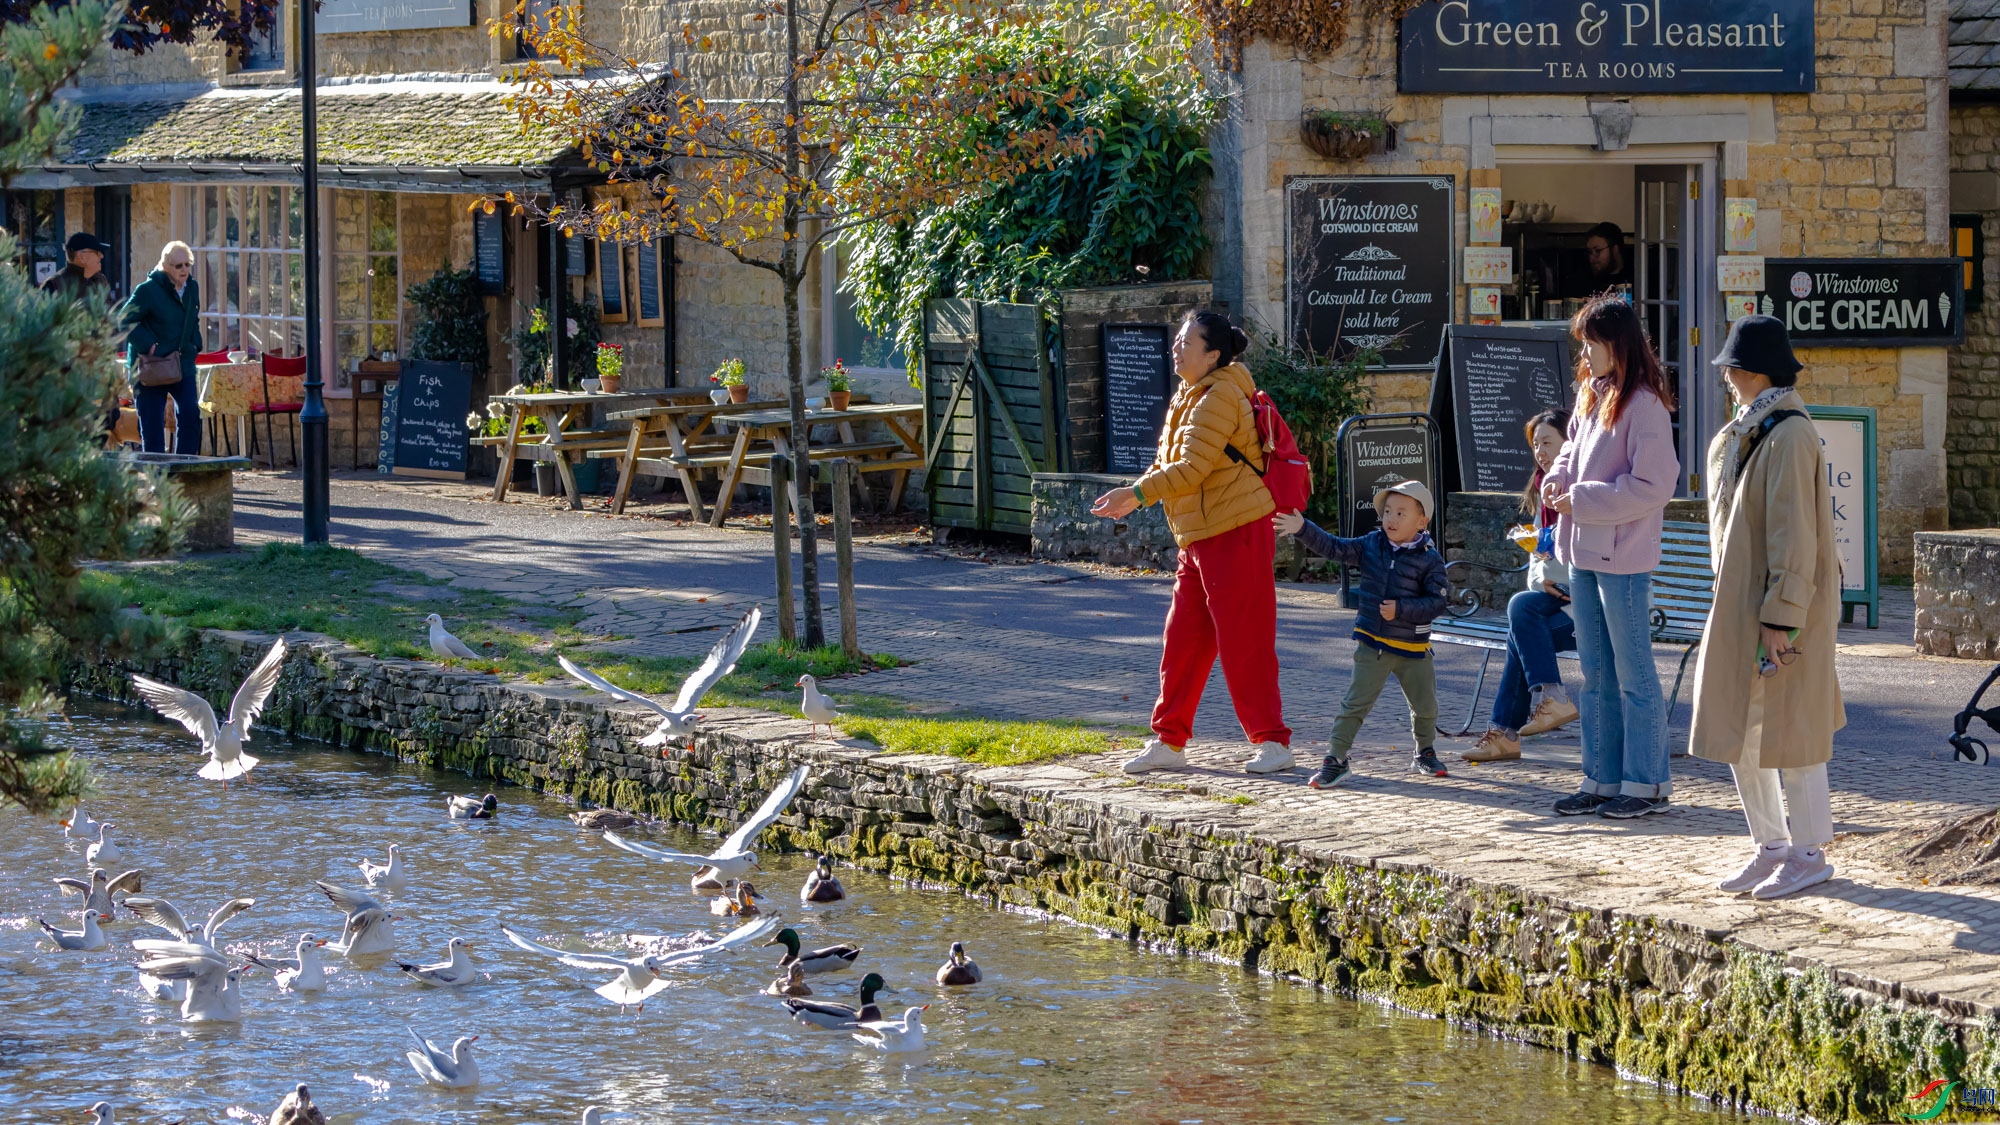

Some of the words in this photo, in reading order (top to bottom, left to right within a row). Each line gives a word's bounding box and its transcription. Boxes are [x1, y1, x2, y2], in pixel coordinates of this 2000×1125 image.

[384, 4, 414, 19] ROOMS
[1435, 1, 1561, 47] Green
[1575, 1, 1608, 47] &
[1621, 0, 1786, 48] Pleasant
[1544, 62, 1589, 79] TEA
[1599, 62, 1676, 79] ROOMS
[1318, 197, 1419, 221] Winstones
[1321, 223, 1371, 234] COTSWOLD
[1372, 223, 1386, 233] ICE
[1386, 223, 1419, 233] CREAM
[1334, 265, 1407, 282] Traditional
[1814, 273, 1899, 295] Winstones
[1307, 289, 1366, 306] Cotswold
[1369, 289, 1388, 304] Ice
[1391, 288, 1433, 304] Cream
[1344, 312, 1371, 329] sold
[1373, 312, 1400, 328] here
[1786, 300, 1826, 331] ICE
[1830, 299, 1929, 330] CREAM
[419, 375, 443, 387] Fish
[413, 397, 440, 410] Chips
[1356, 441, 1423, 458] Winstones
[1357, 458, 1391, 467] COTSWOLD
[1391, 457, 1401, 465] ICE
[1401, 456, 1423, 465] CREAM
